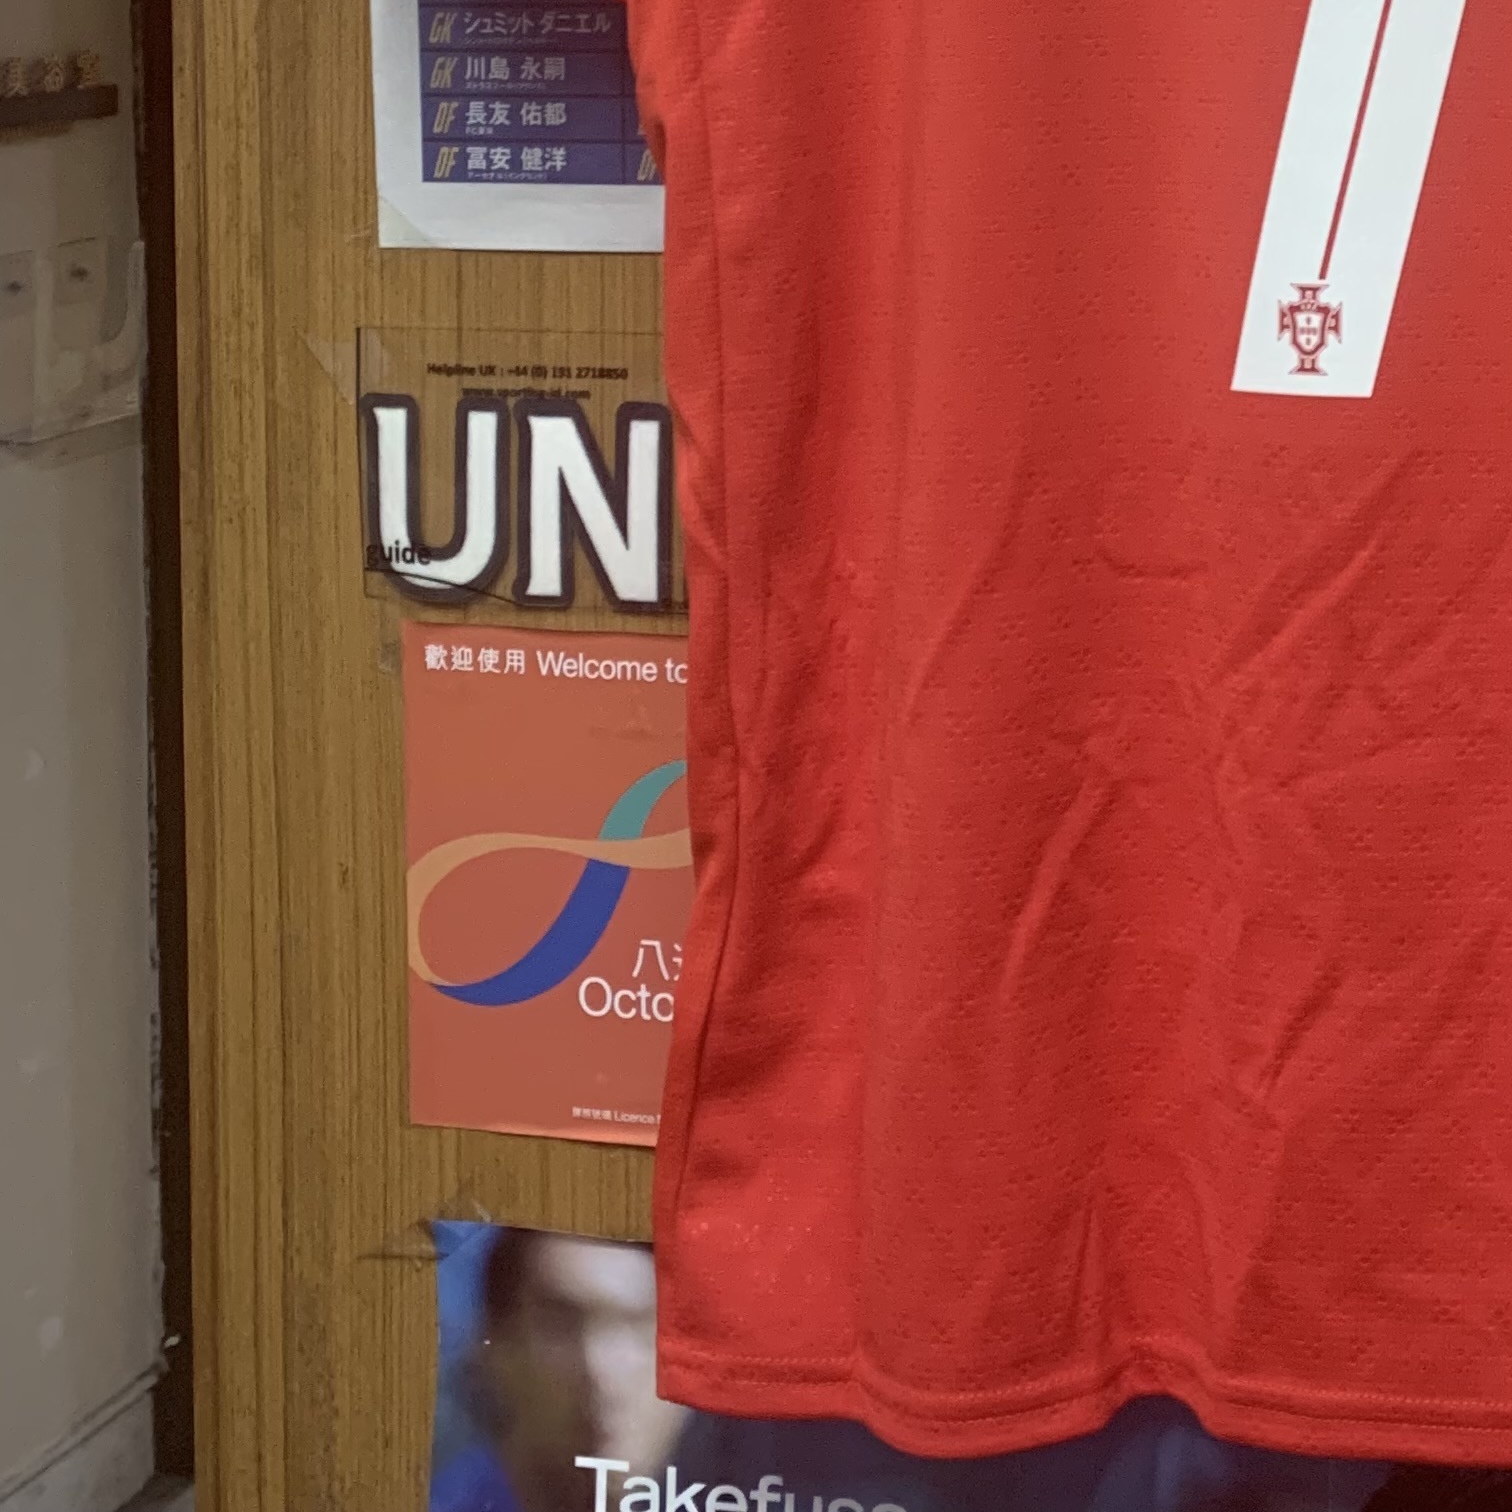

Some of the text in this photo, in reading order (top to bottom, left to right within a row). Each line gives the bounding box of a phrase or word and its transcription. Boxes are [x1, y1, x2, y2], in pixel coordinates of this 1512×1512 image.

[428, 12, 459, 44] GK
[463, 10, 611, 35] シュミット ダニエル
[430, 56, 458, 88] GK
[465, 56, 510, 81] 川島
[432, 101, 460, 134] DF
[465, 101, 567, 126] 長友 佑都
[433, 146, 460, 179] DF
[520, 146, 567, 172] 健洋
[427, 363, 476, 378] Helpline
[479, 364, 497, 377] UK
[360, 392, 675, 613] UN
[365, 539, 432, 567] guide
[424, 644, 526, 675] 歡迎使用
[537, 650, 657, 683] Welcome
[574, 1455, 908, 1512] Takef
